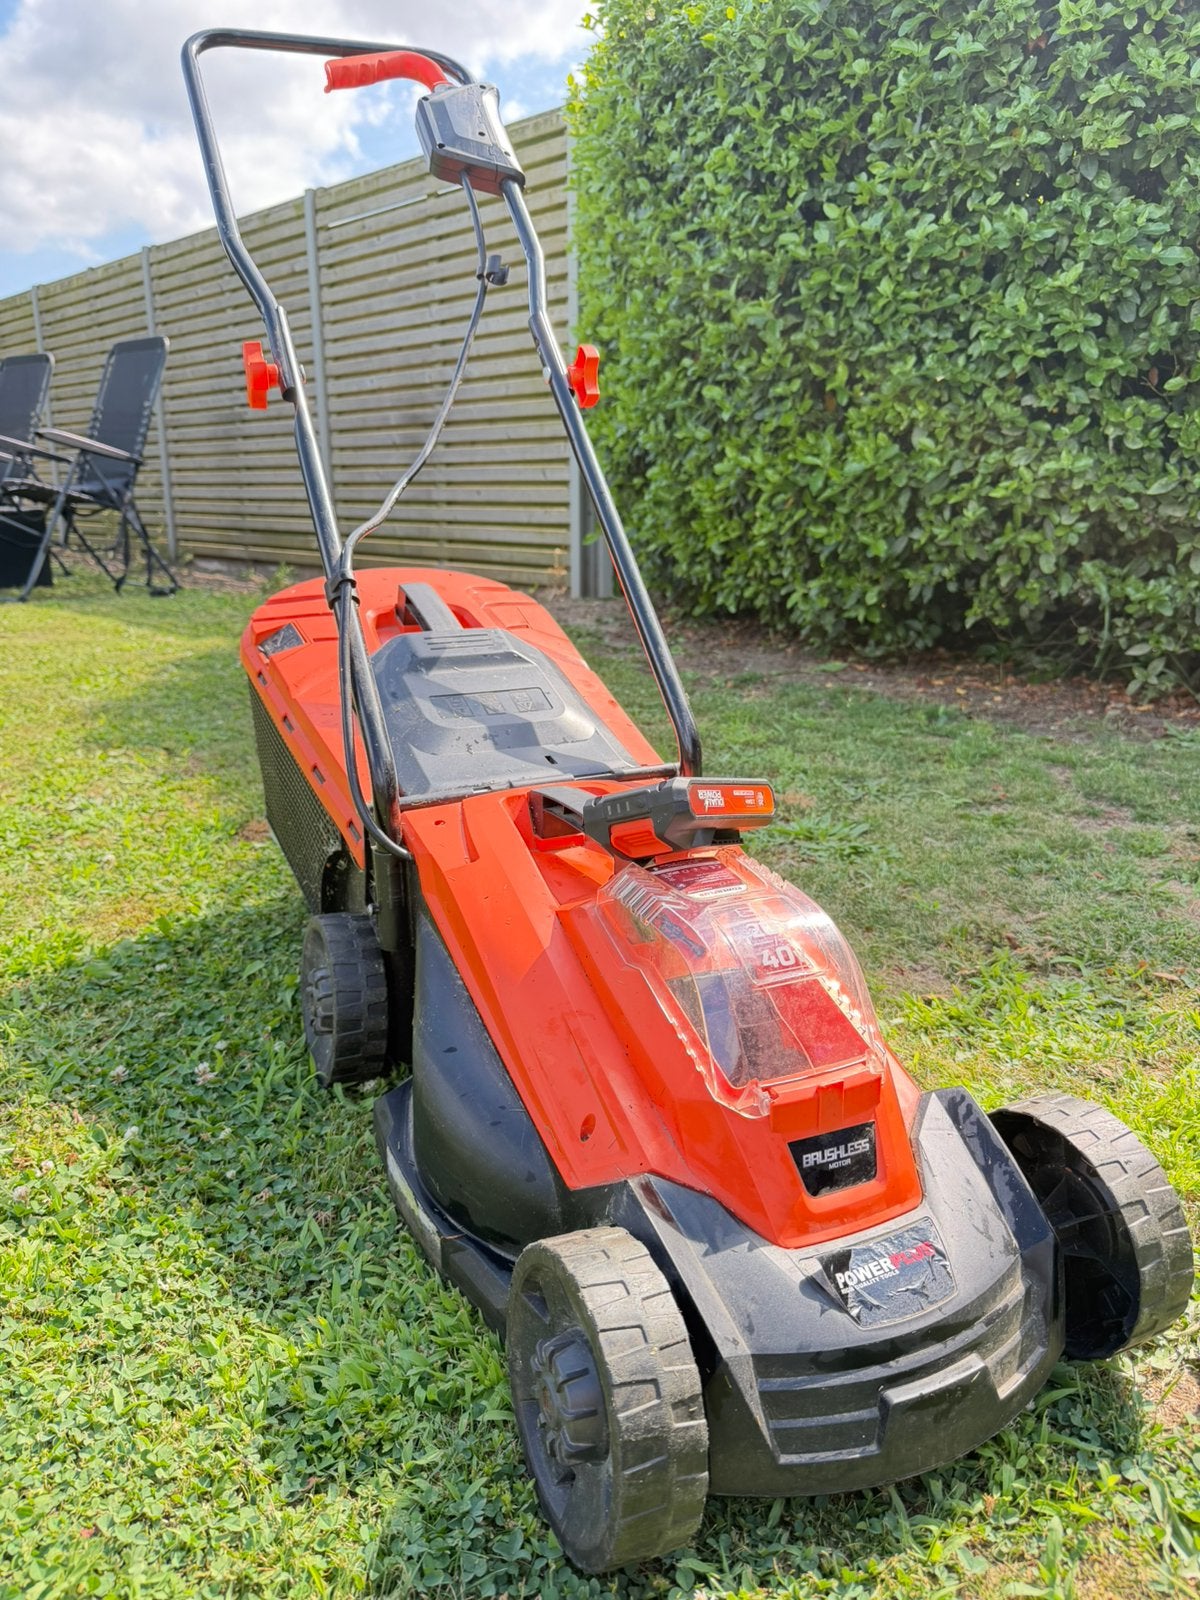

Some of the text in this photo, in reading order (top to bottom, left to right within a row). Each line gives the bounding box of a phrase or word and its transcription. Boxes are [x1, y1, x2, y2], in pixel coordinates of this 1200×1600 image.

[698, 790, 721, 799] POWER
[802, 1138, 870, 1168] BRUSHLESS
[828, 1158, 851, 1170] MOTOR
